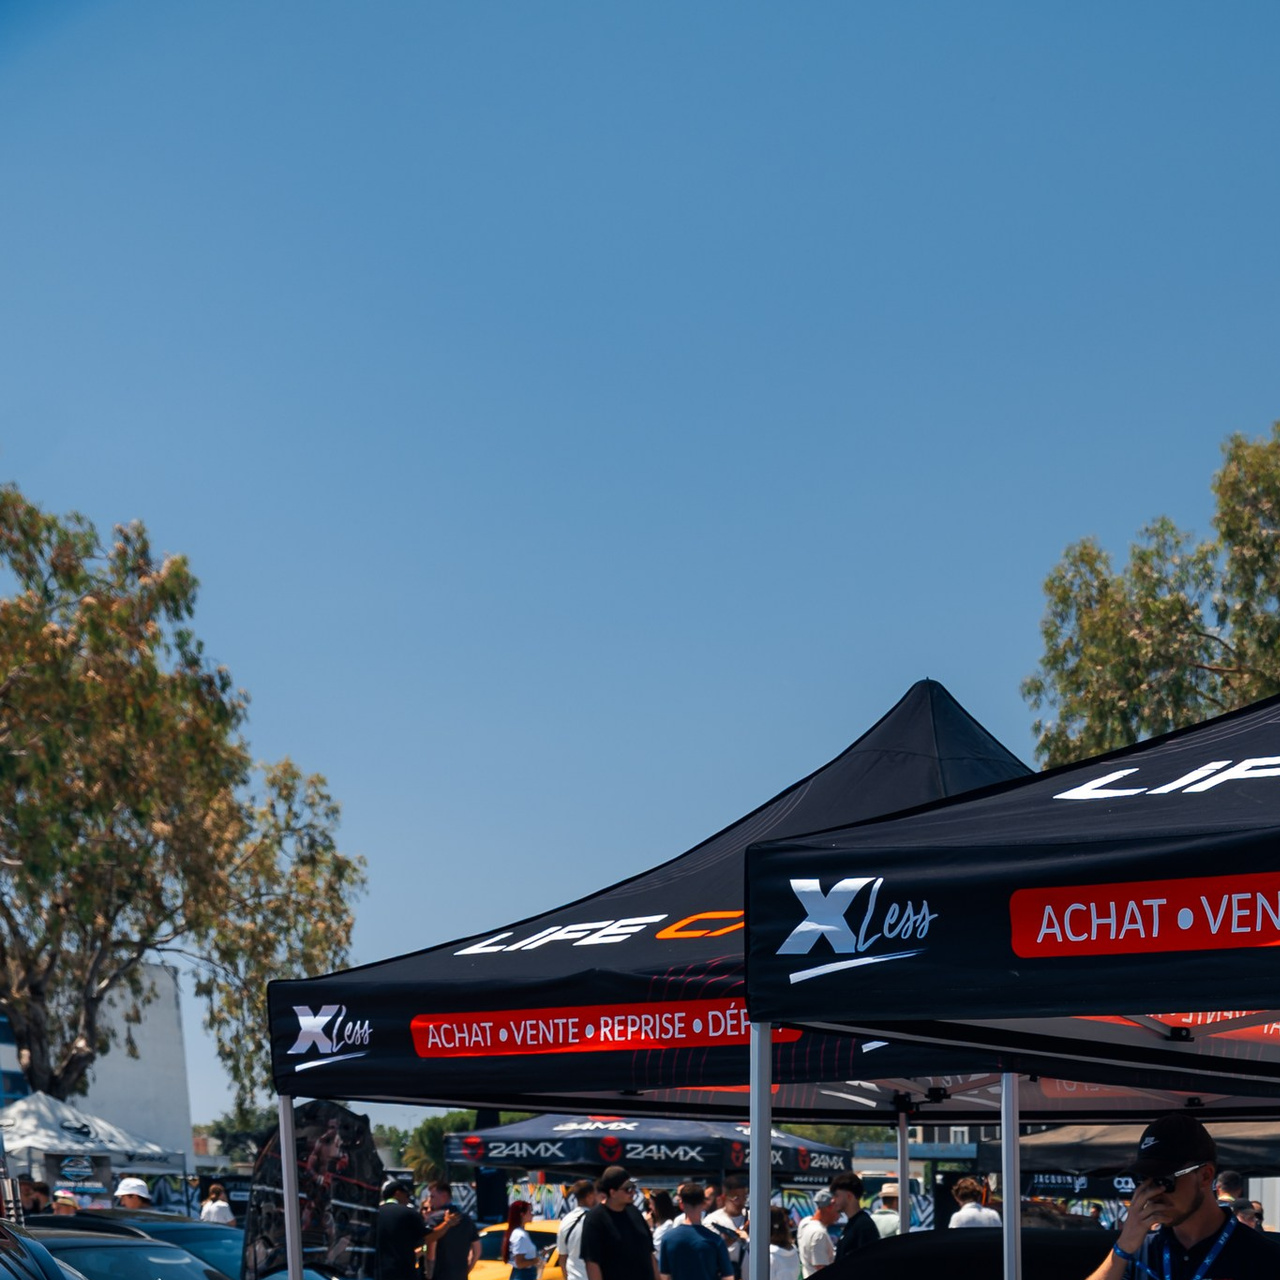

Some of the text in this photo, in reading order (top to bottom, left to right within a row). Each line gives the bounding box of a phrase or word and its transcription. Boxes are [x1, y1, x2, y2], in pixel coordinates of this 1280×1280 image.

[453, 914, 669, 956] LIFE
[1036, 898, 1167, 944] ACHAT
[427, 1002, 750, 1049] ACHAT VENTE REPRISE DÉP
[488, 1142, 565, 1158] 24MX
[626, 1143, 704, 1162] 24MX
[810, 1153, 845, 1170] 24MX
